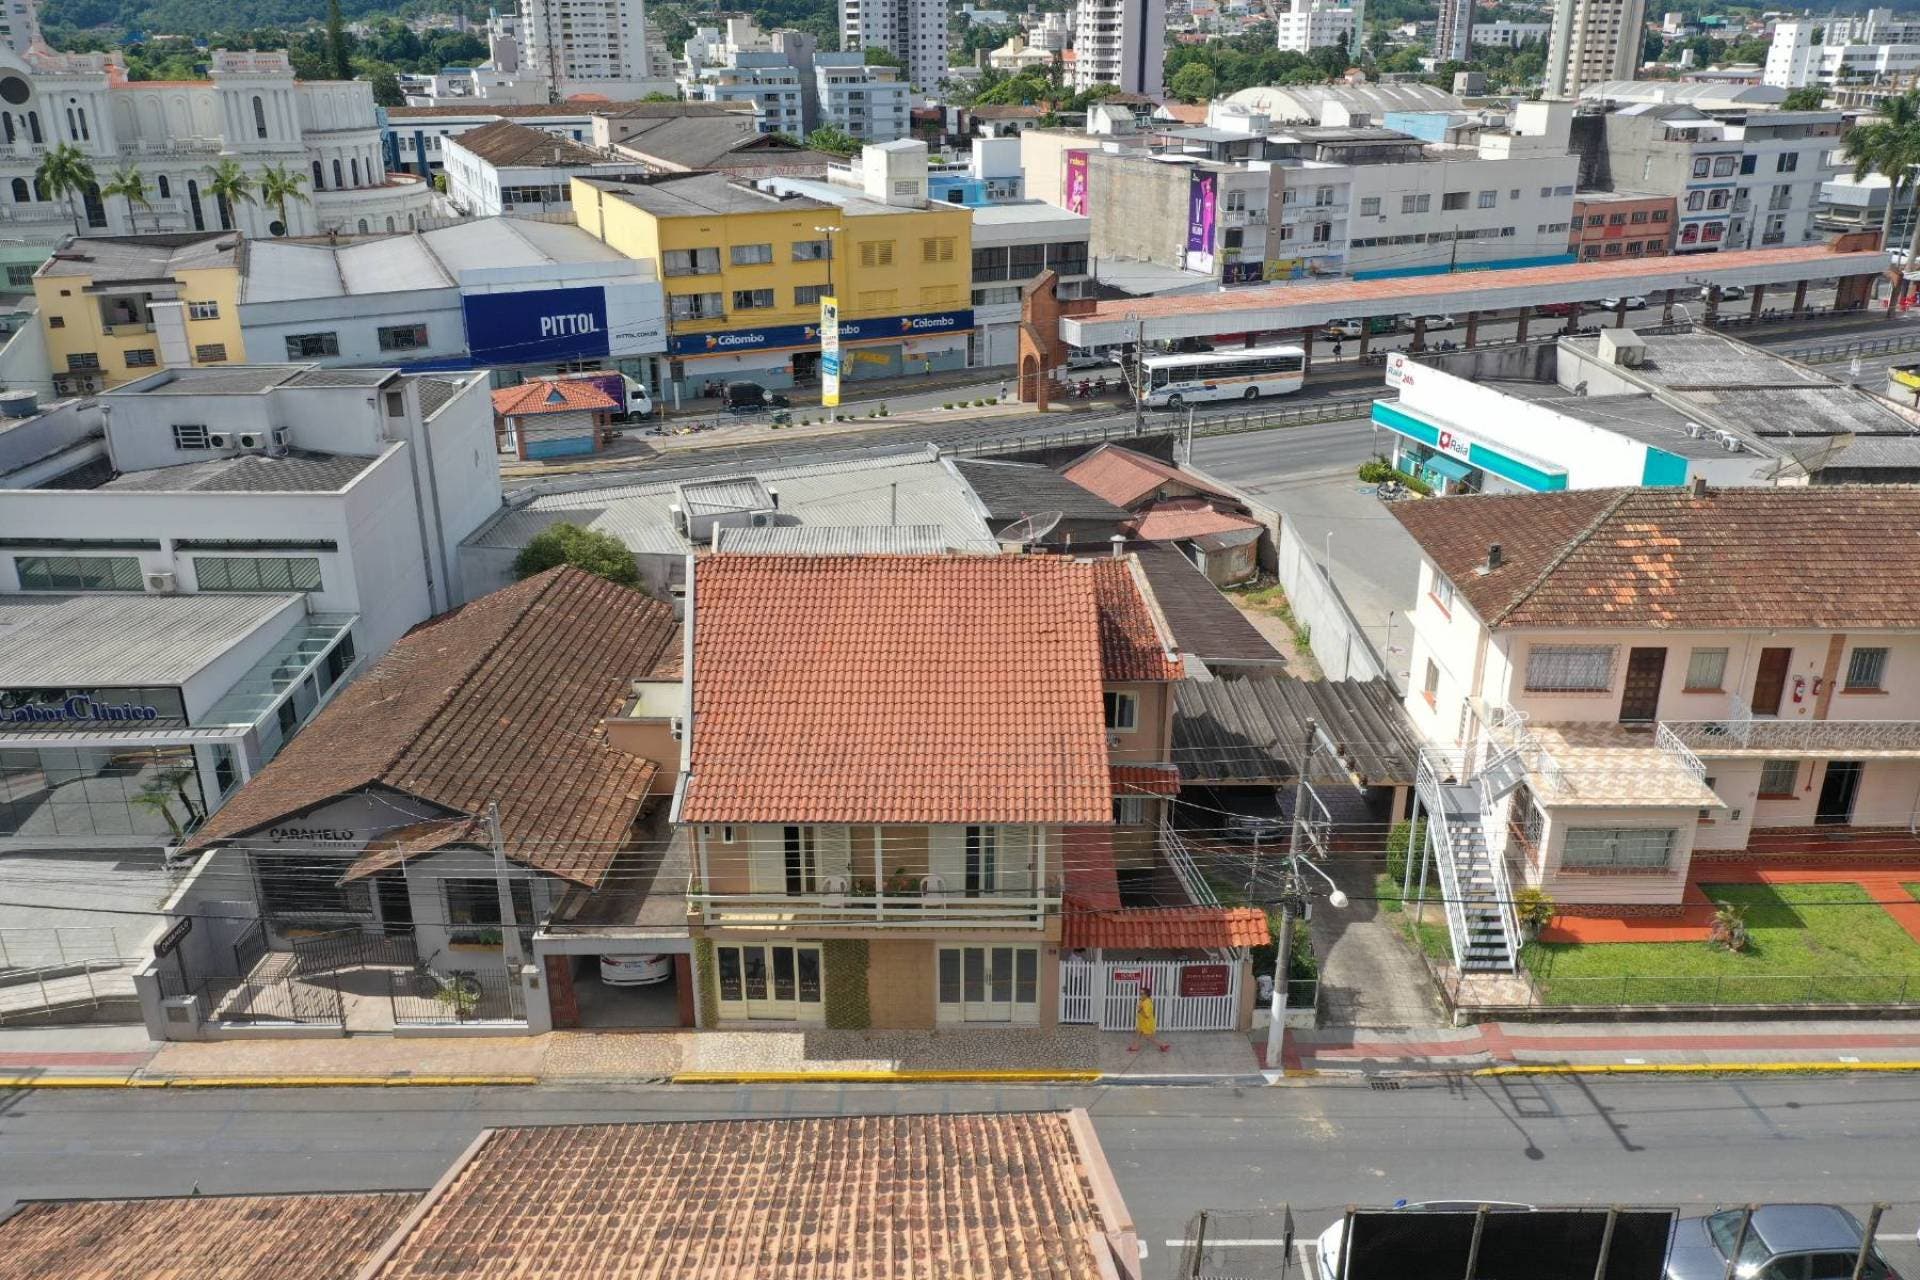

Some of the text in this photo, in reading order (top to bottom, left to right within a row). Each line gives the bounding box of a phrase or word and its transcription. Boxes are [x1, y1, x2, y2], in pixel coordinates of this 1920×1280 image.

[540, 313, 600, 336] PITTOL
[909, 317, 955, 328] Colombo
[718, 333, 765, 346] Colombo
[1451, 439, 1469, 456] Raia
[269, 828, 354, 843] CARAMELO
